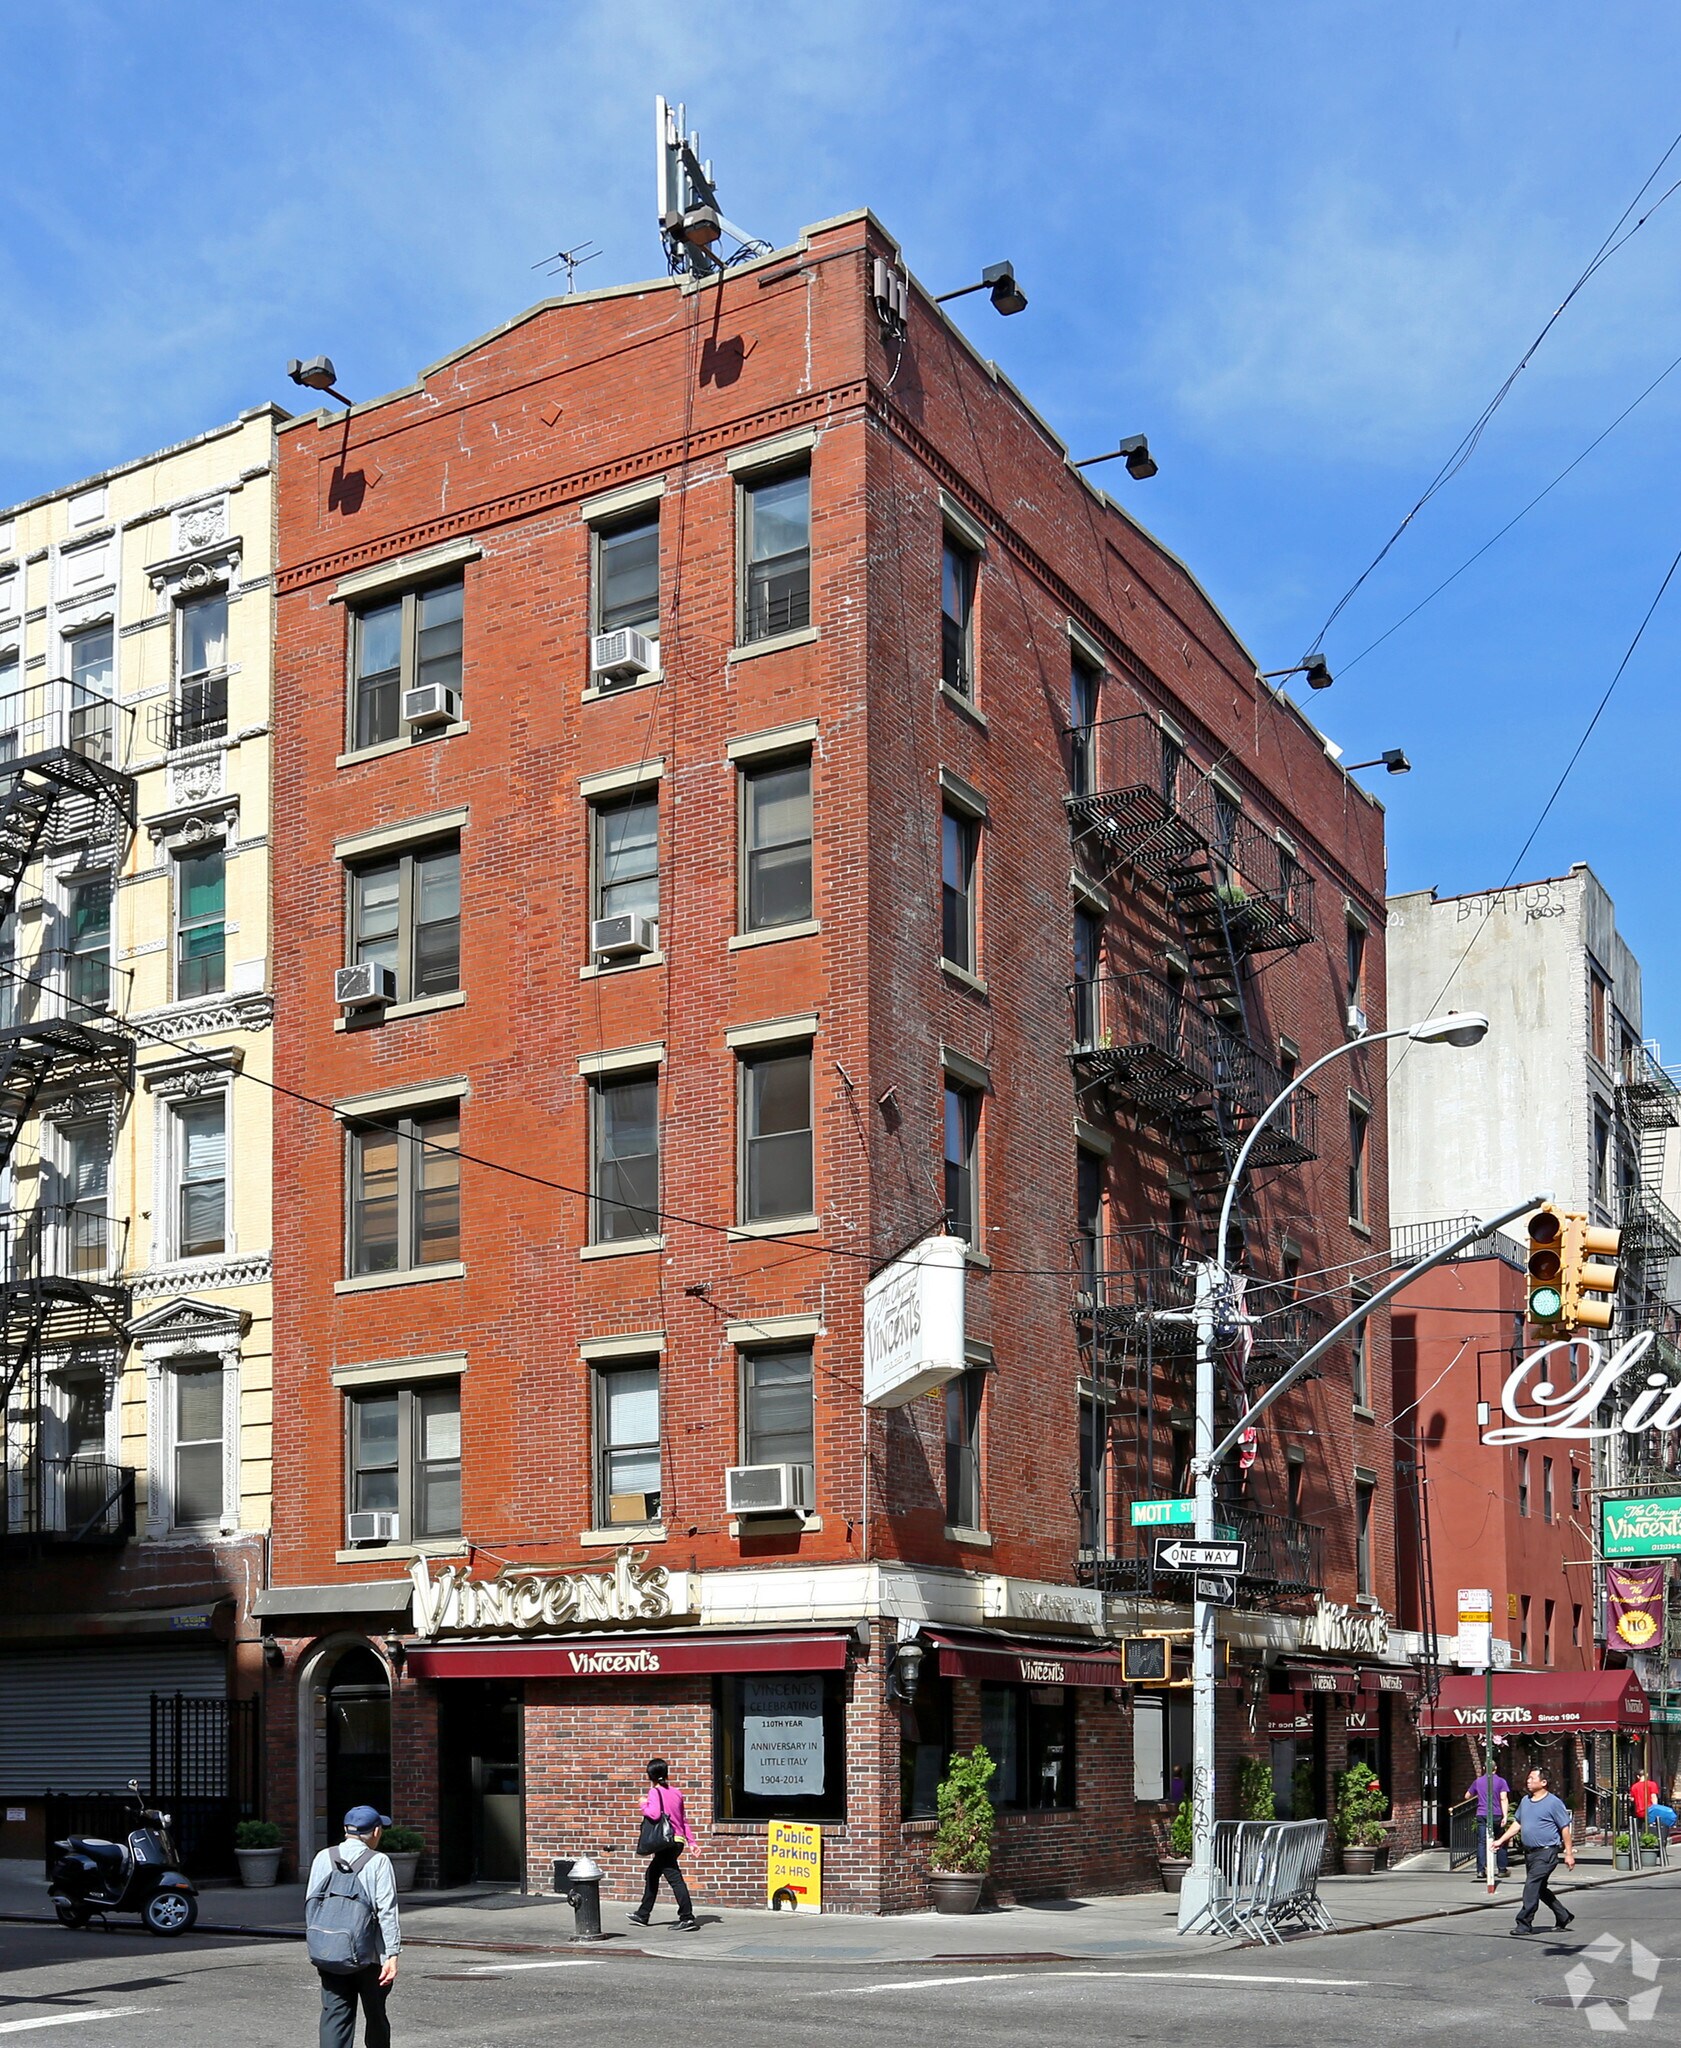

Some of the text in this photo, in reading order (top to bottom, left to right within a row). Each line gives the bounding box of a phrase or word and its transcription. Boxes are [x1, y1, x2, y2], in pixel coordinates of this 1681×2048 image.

[1134, 1504, 1172, 1522] MOTT
[1624, 1504, 1644, 1518] The
[1172, 1549, 1231, 1562] ONE WAY
[404, 1547, 672, 1635] Vincent's
[1201, 1581, 1212, 1593] ONE
[568, 1651, 660, 1673] Vincent's
[1020, 1658, 1065, 1681] Vincent's
[751, 1683, 816, 1696] VINCENTS
[750, 1701, 817, 1712] CELEBRATING
[762, 1720, 783, 1728] 110TH
[1538, 1714, 1559, 1722] Since
[1561, 1713, 1580, 1721] 1904
[750, 1742, 817, 1751] ANNIVERSARY IN
[760, 1757, 808, 1766] LITTLE ITALY
[760, 1775, 804, 1784] 1904-2014
[776, 1829, 812, 1845] Public
[771, 1844, 817, 1865] Parking
[775, 1865, 810, 1878] 24 HRS
